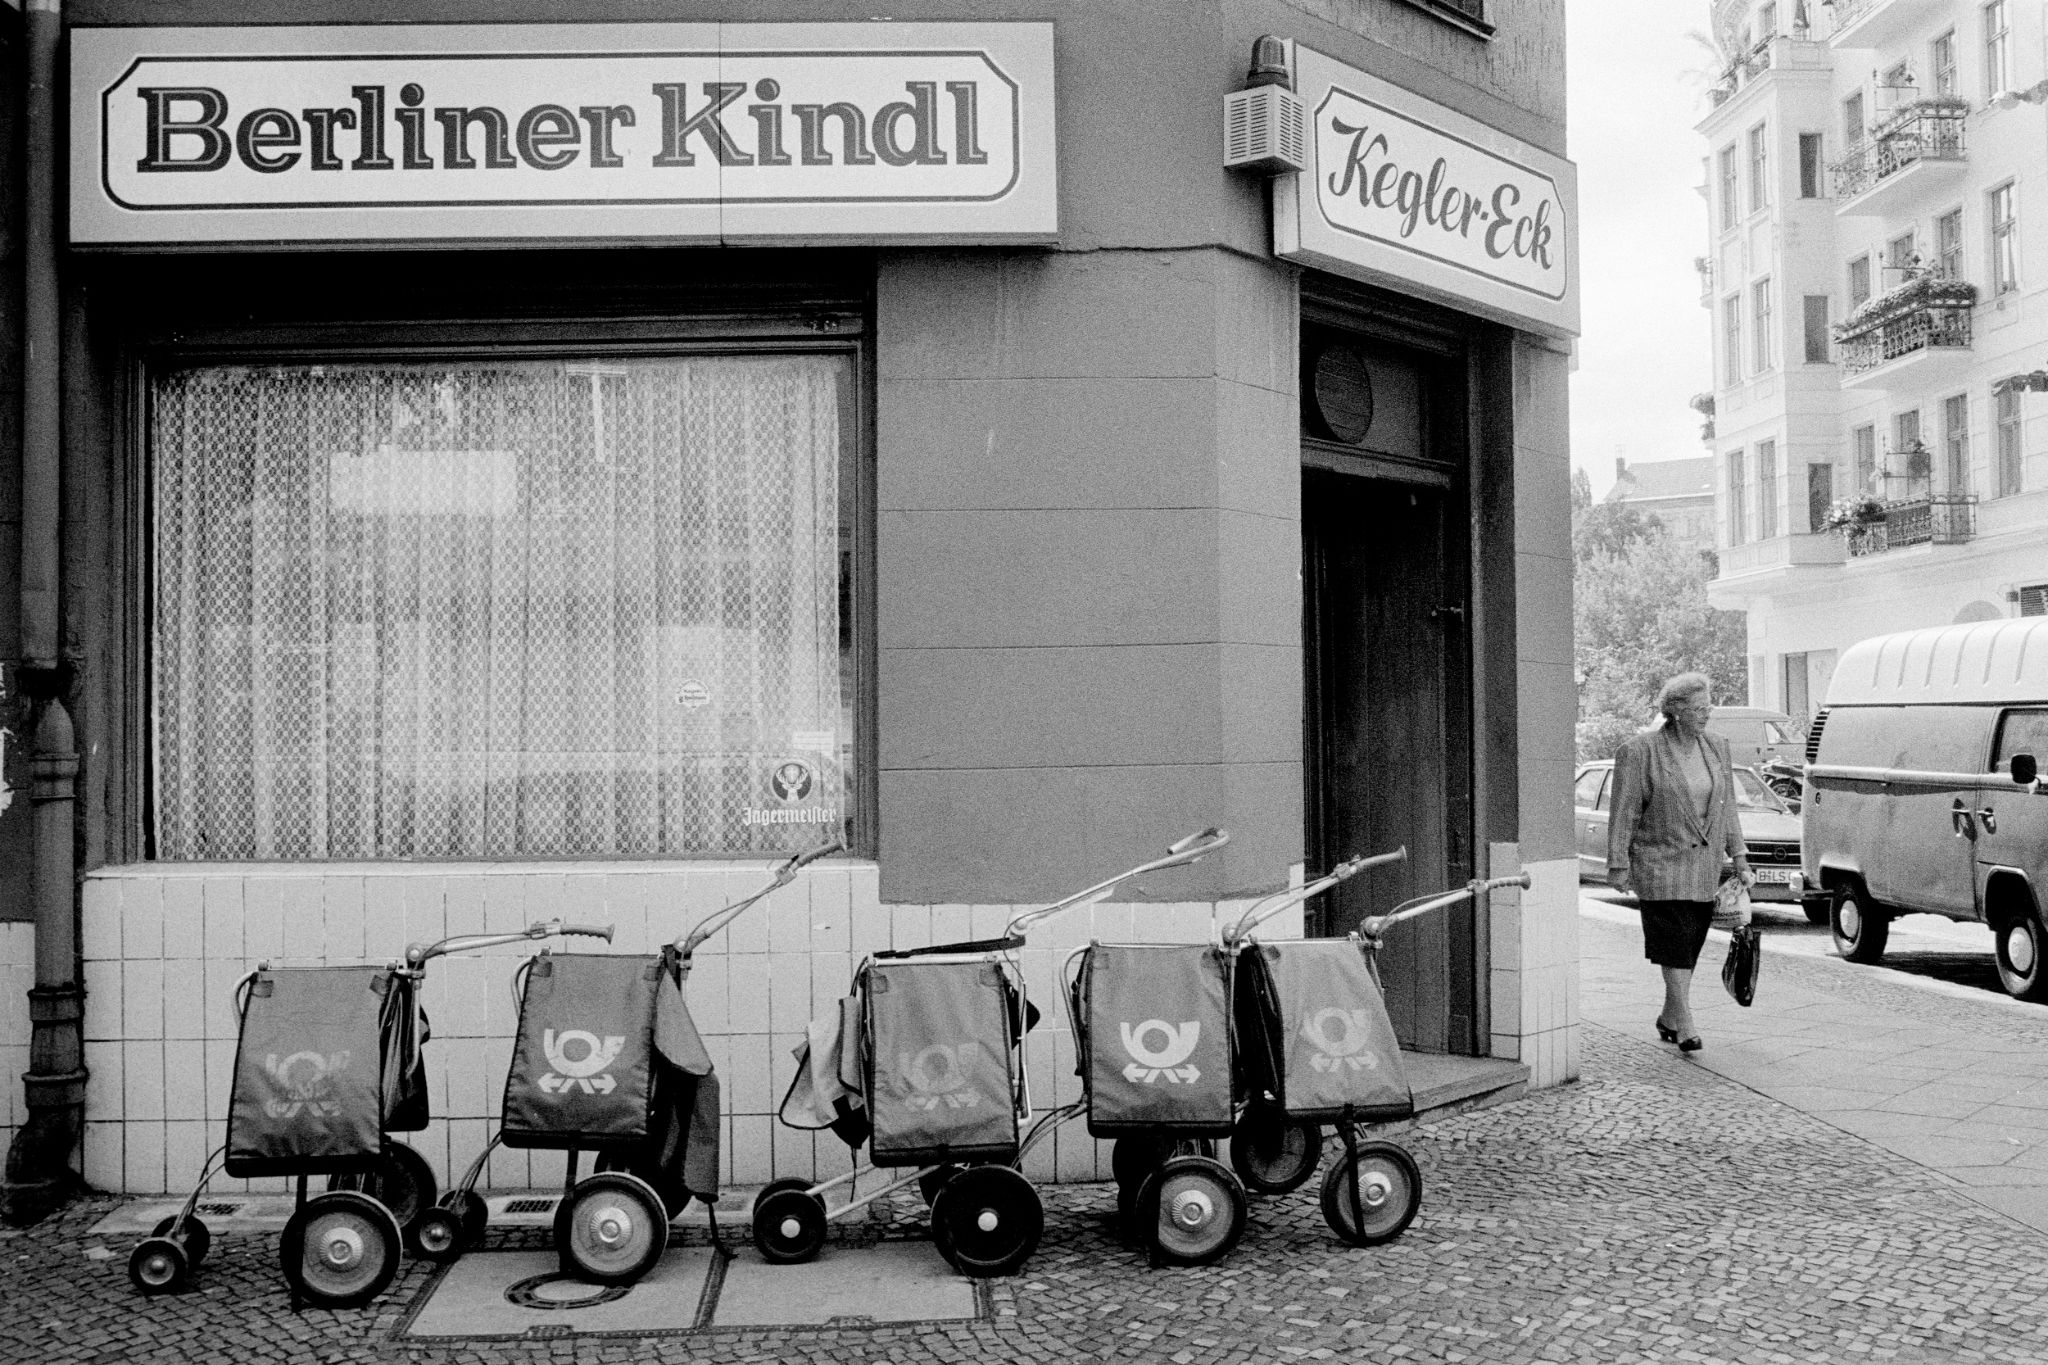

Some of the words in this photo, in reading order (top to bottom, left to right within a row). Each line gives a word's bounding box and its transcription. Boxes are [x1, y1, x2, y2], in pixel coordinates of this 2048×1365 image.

[136, 82, 636, 174] Berliner
[651, 77, 989, 168] Kindl
[1327, 115, 1553, 270] Kegler-Eck
